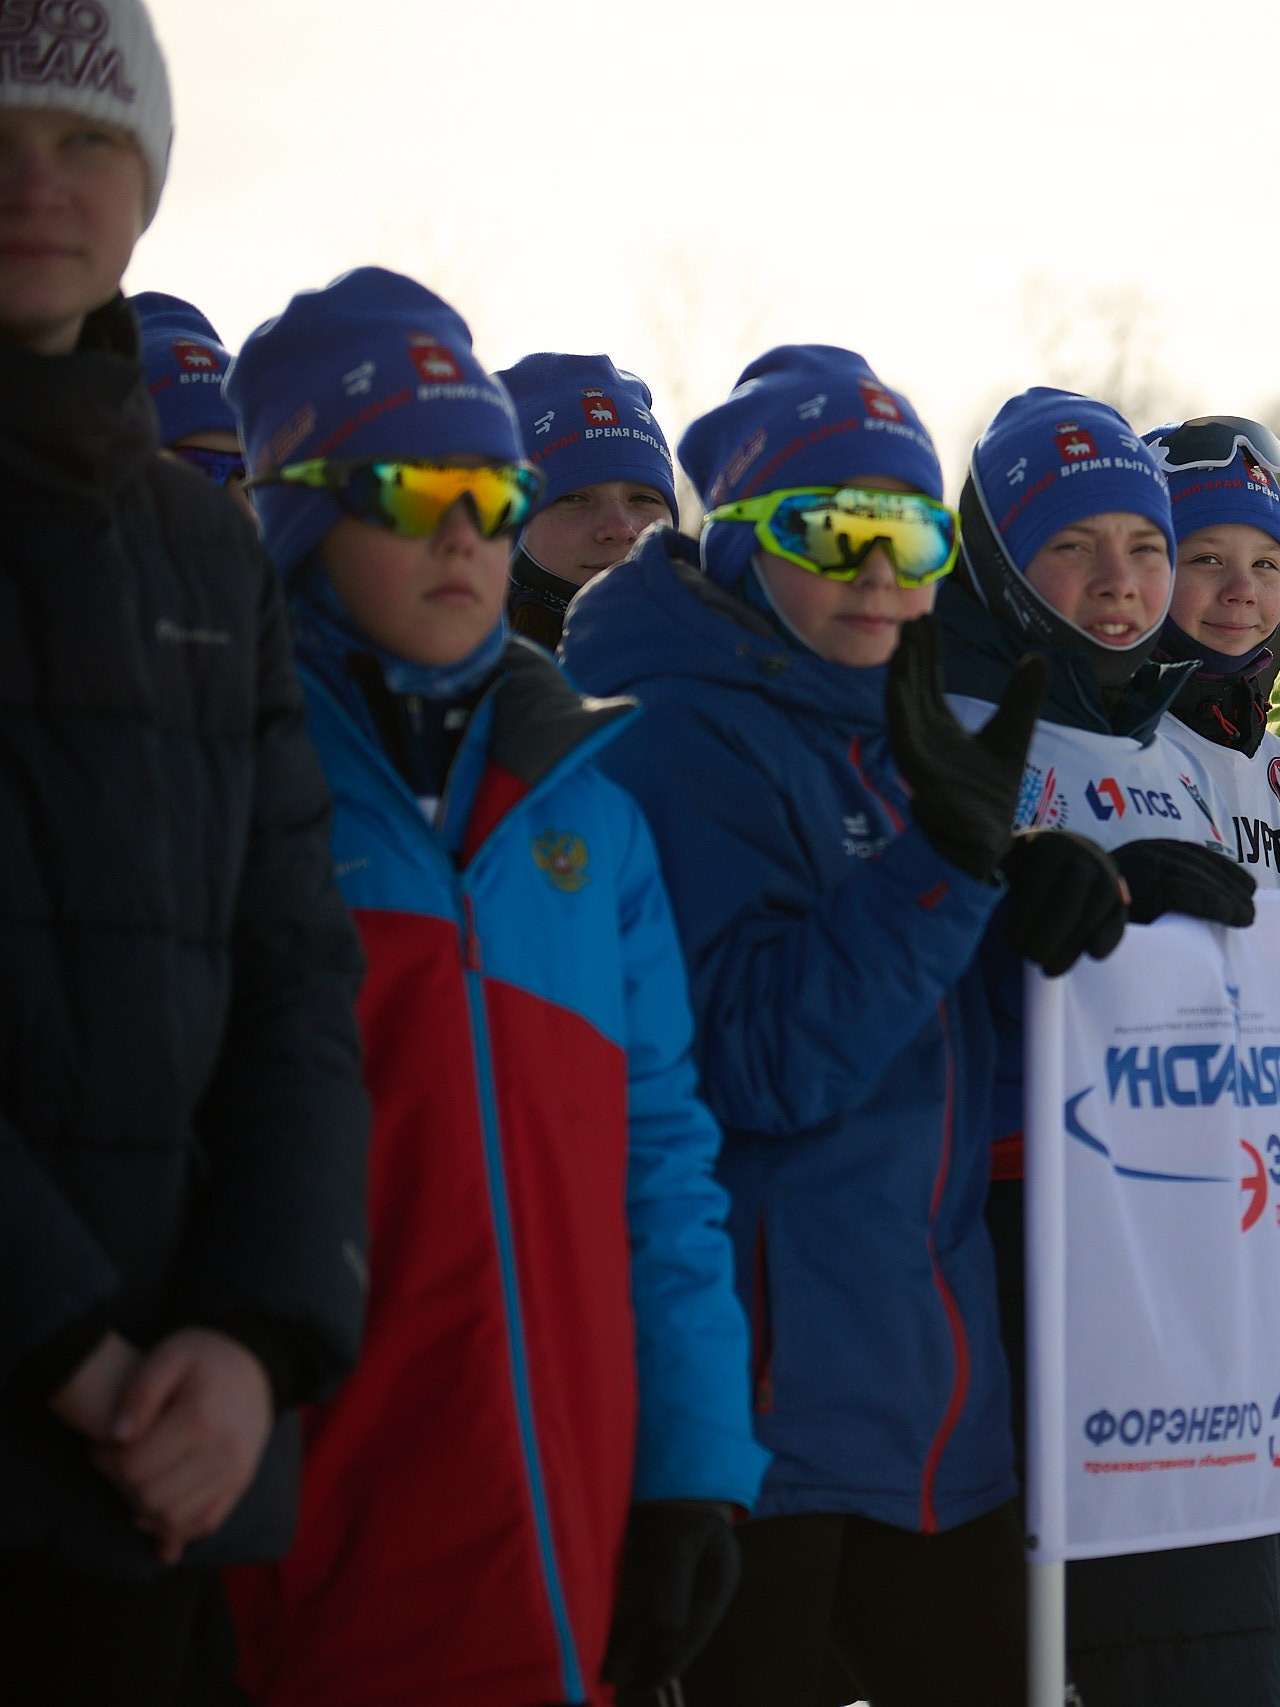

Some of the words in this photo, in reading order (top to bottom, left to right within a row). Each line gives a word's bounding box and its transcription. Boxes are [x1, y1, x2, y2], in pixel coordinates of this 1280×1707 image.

[180, 373, 223, 384] ВРЕМ
[585, 427, 630, 440] ВРЕМЯ
[633, 429, 659, 449] БЫТЬ
[1061, 456, 1112, 478] ВРЕМЯ
[1115, 456, 1151, 476] БЫТЬ
[1126, 786, 1182, 820] ПСБ
[1084, 1402, 1262, 1448] ФОРЭНЕРГО
